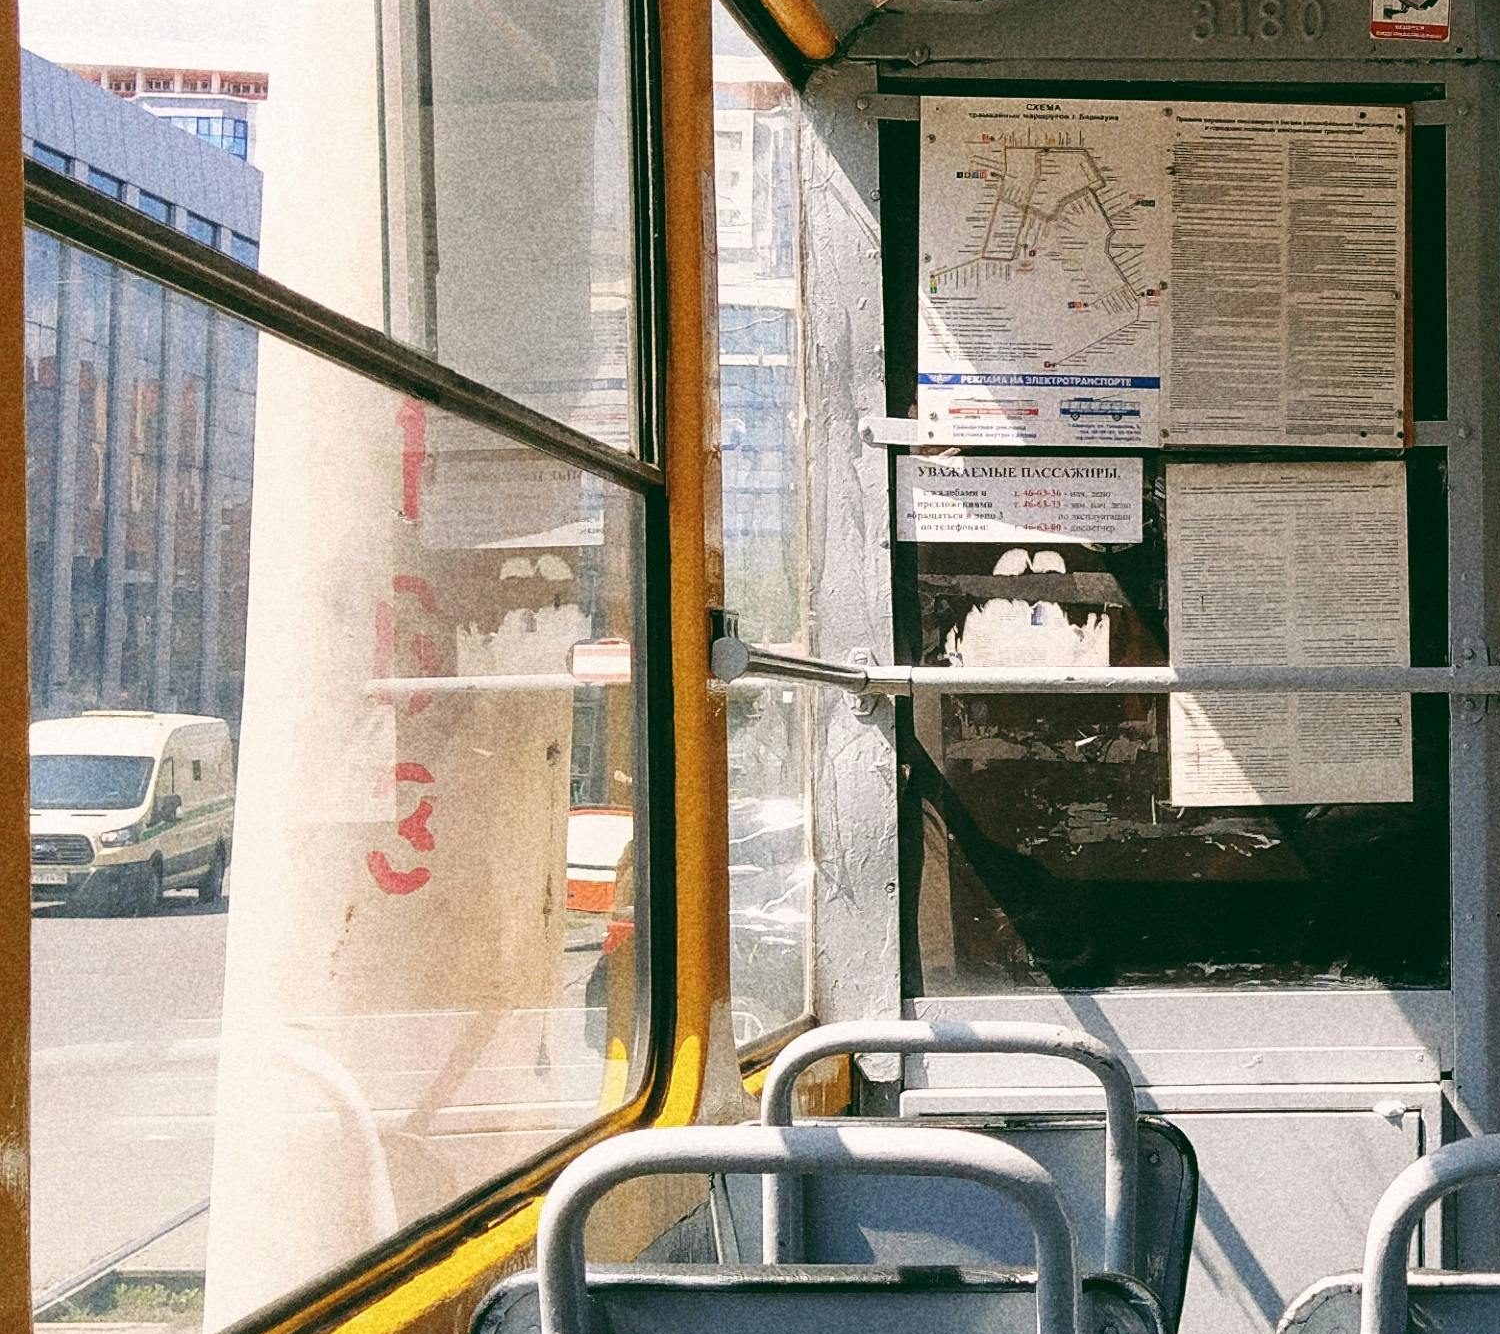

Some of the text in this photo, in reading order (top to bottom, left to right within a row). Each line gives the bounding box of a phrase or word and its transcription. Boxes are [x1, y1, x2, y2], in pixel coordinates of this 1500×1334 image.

[1026, 103, 1062, 112] СХЕМА
[960, 375, 1009, 386] РЕКЛАМА
[1010, 376, 1024, 386] НА
[918, 466, 1017, 478] УВАЖАЕМЫЕ
[917, 501, 993, 509] предложениями
[906, 511, 963, 521] обращаться
